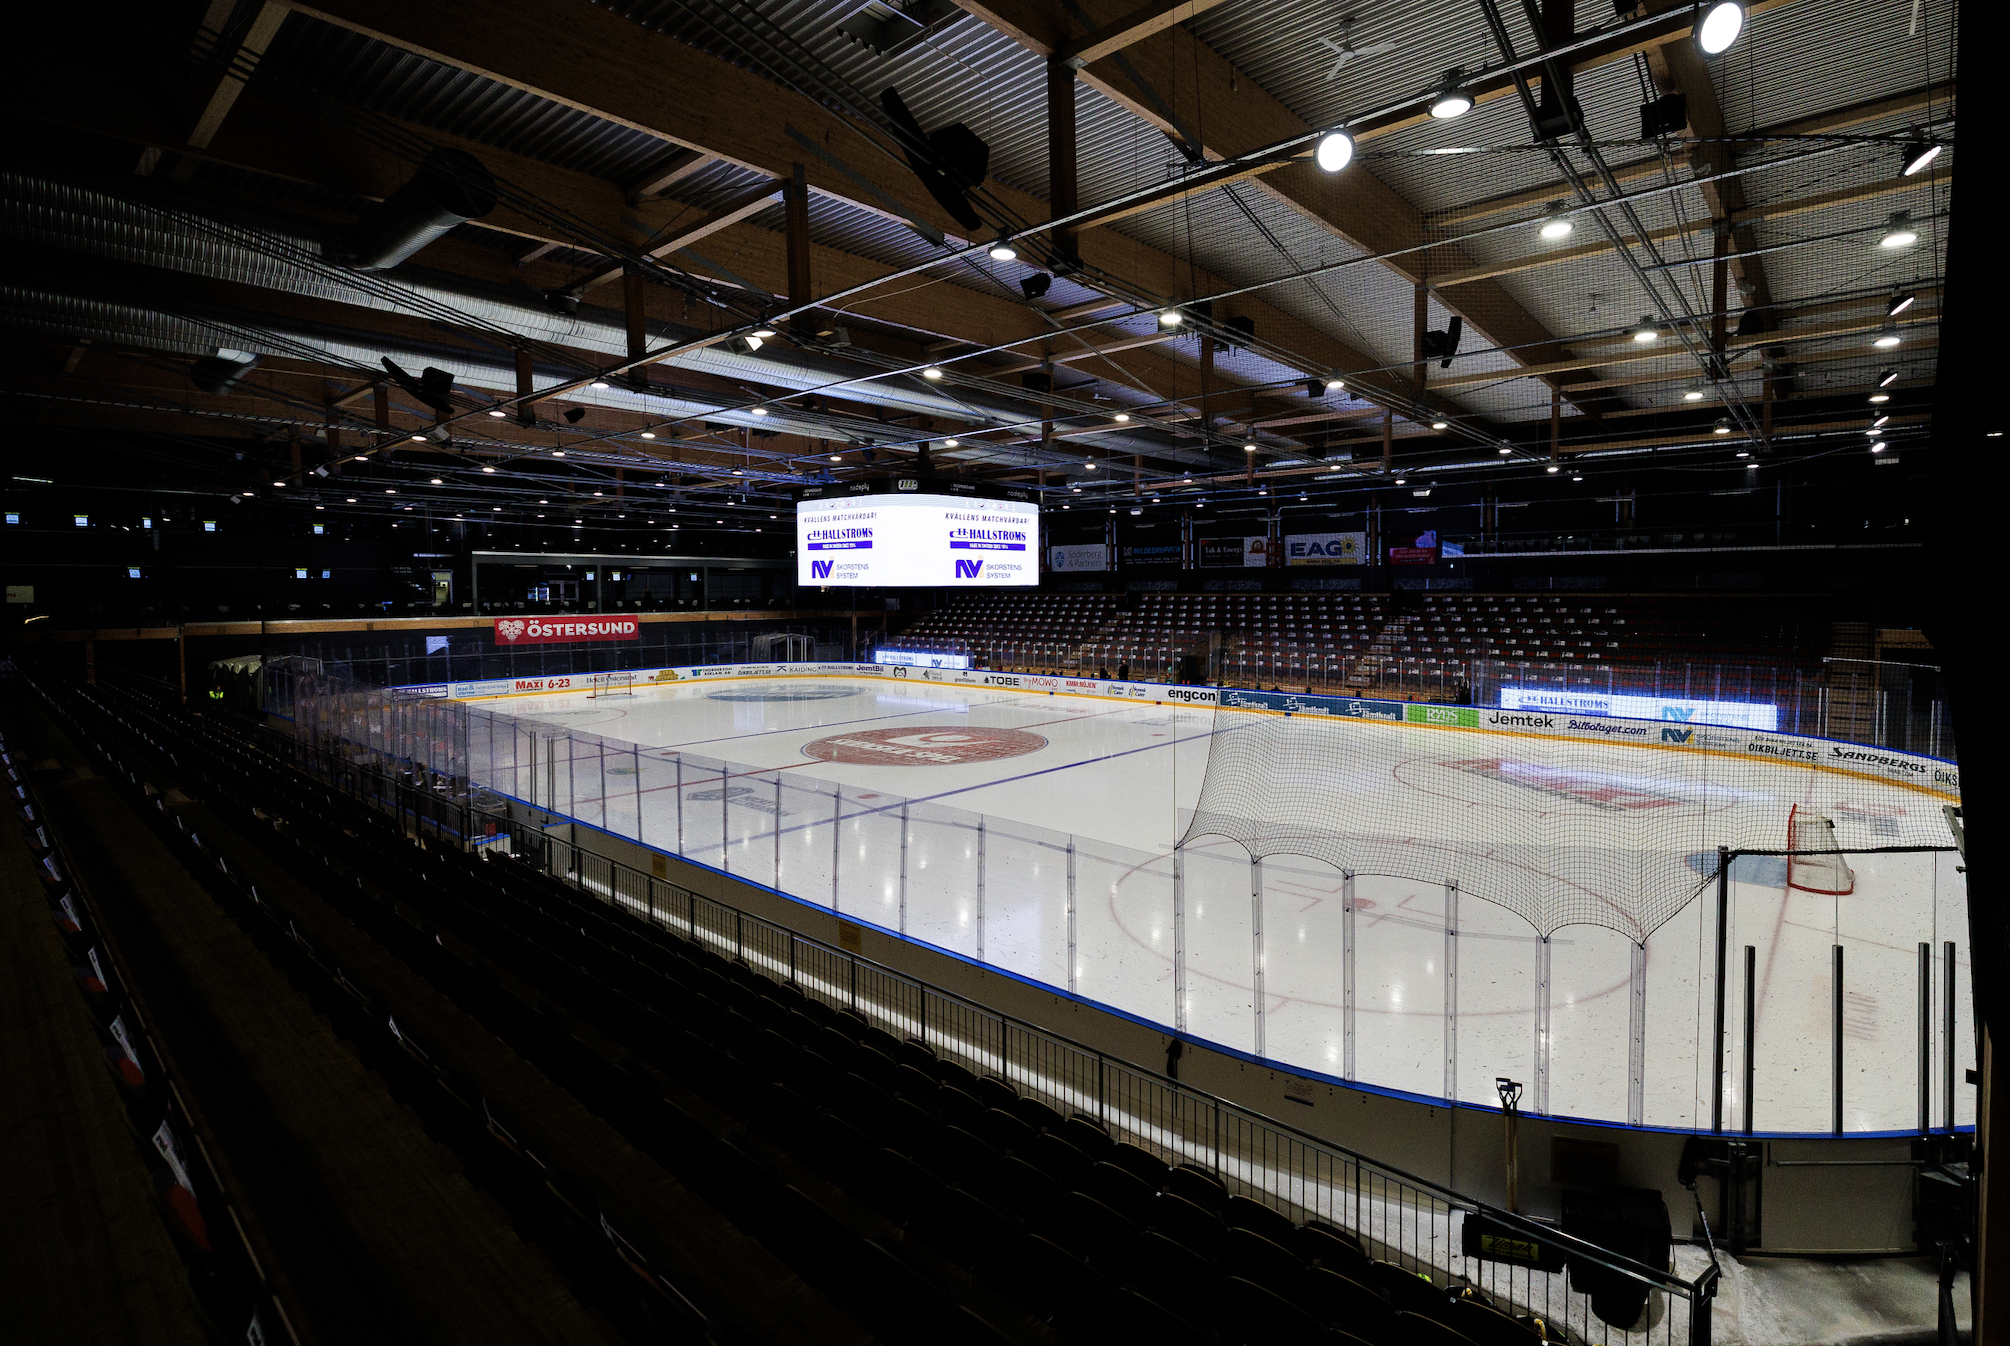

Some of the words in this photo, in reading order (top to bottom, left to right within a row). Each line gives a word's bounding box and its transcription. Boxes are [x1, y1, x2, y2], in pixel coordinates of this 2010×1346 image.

[804, 514, 831, 523] KVÄLLENS
[832, 512, 877, 521] MATCHVÄRDAR!
[945, 512, 979, 521] KVÄLLENS
[982, 515, 1030, 524] MATCHVÄRDAR!
[1290, 540, 1342, 557] EAG
[836, 563, 869, 571] SKORSTENS
[986, 563, 1022, 571] SKORSTENS
[1074, 559, 1102, 567] Partners
[527, 619, 636, 638] ÖSTERSUND
[515, 680, 543, 690] MAXI
[548, 678, 570, 689] 6-23
[990, 675, 1020, 686] TOBE
[1168, 689, 1216, 702] engcon
[1489, 711, 1554, 728] Jemtek
[1567, 719, 1647, 736] Bilbolaget.com
[1748, 742, 1818, 761] ÖIKBILJETT.SE
[1828, 747, 1927, 774] SANDBERGS
